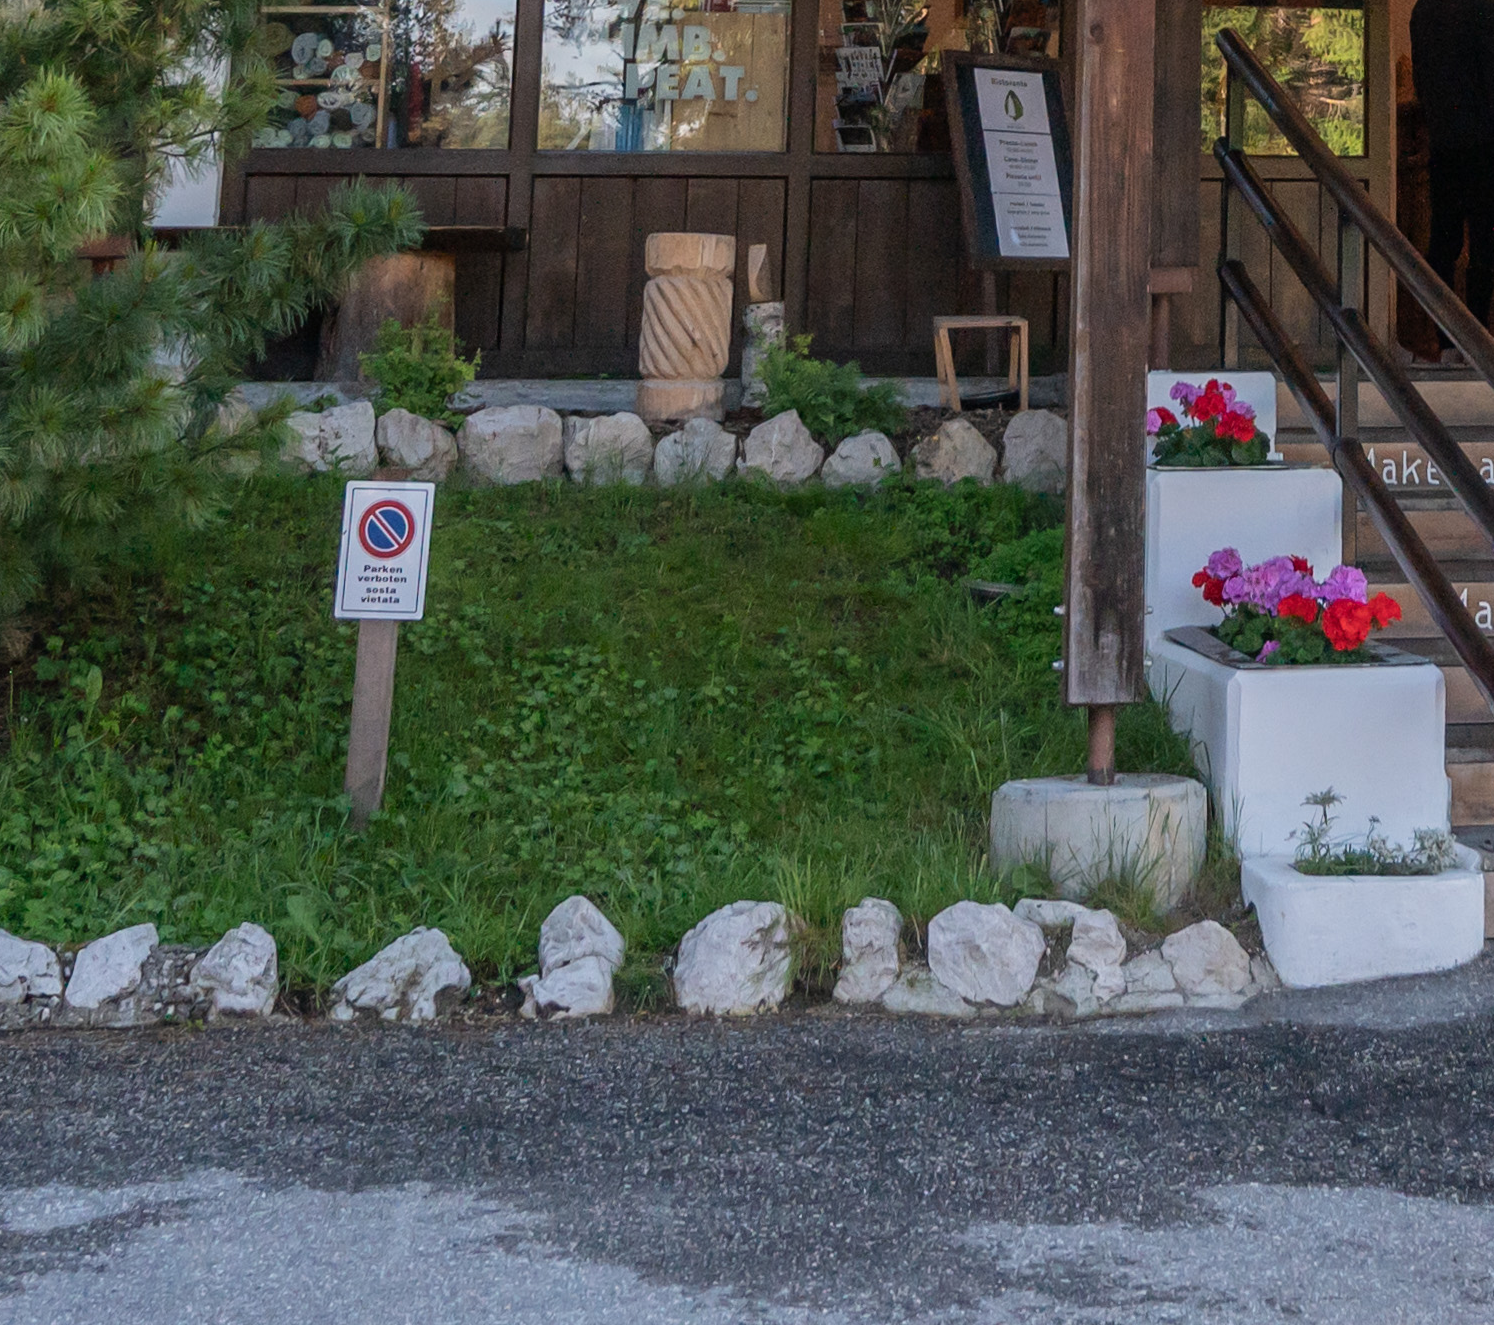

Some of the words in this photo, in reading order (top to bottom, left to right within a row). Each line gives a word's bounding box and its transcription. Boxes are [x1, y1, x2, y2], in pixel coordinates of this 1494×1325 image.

[625, 63, 758, 101] PEAT.
[363, 564, 403, 574] Parken
[357, 575, 407, 583] verboten
[366, 586, 397, 594] sosta
[361, 595, 400, 604] vietata
